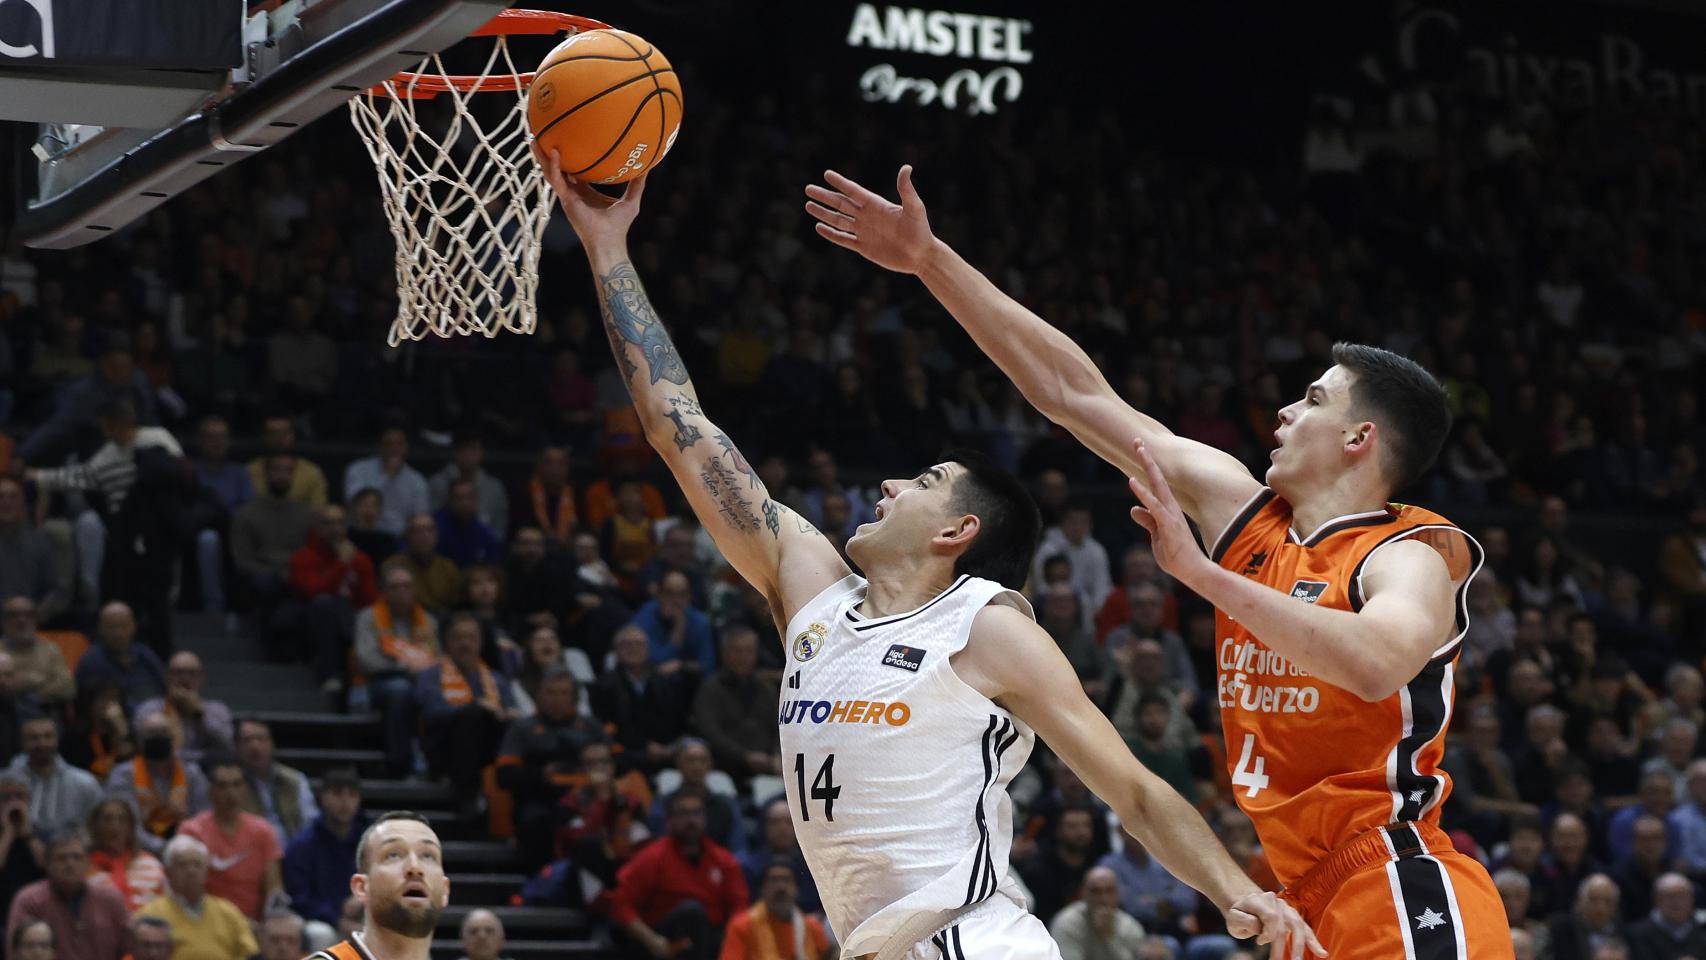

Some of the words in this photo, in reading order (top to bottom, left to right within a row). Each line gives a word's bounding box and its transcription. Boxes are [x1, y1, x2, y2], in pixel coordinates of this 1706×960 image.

[847, 3, 1033, 63] AMSTEL
[885, 657, 919, 670] endesa
[889, 650, 905, 659] liga
[794, 753, 842, 822] 14
[1231, 733, 1270, 798] 4
